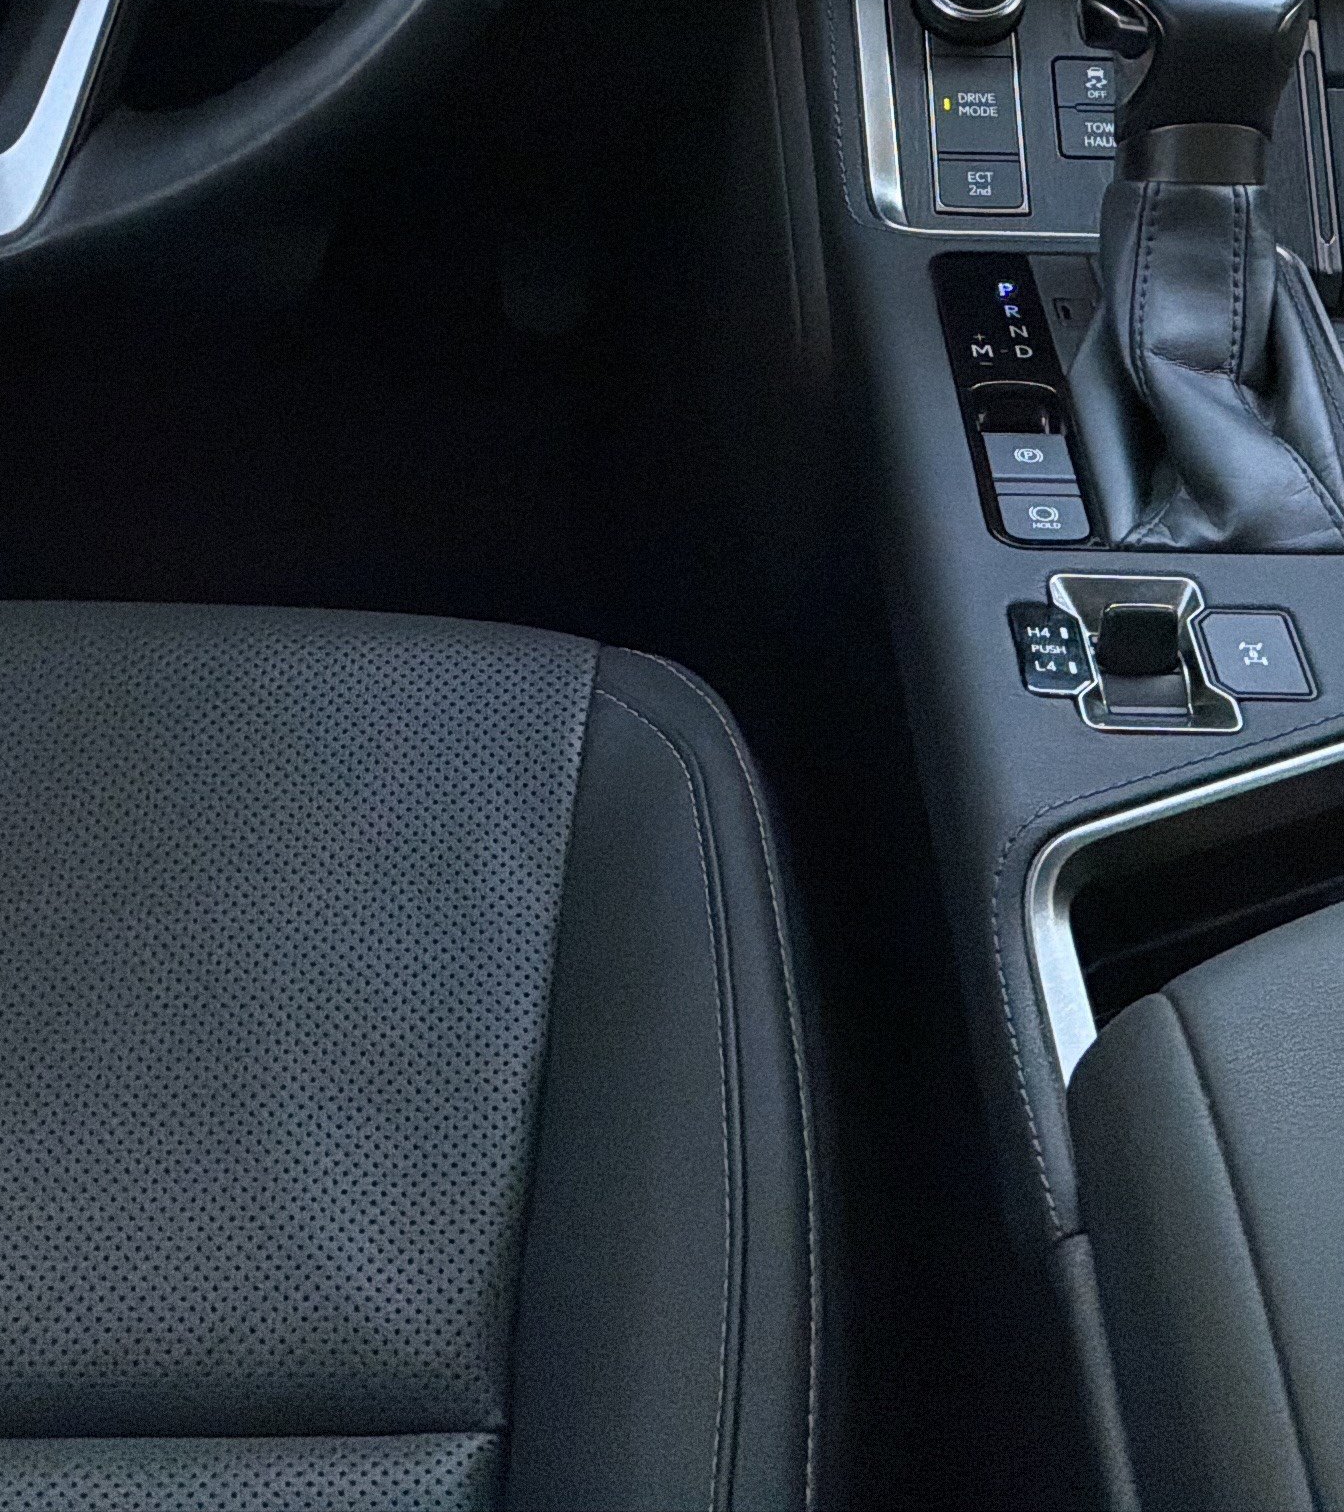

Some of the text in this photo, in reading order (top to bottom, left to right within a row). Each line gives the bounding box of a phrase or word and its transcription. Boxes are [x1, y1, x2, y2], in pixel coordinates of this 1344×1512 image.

[958, 92, 997, 105] DRIVE
[1087, 89, 1107, 100] OFF
[958, 105, 999, 118] MODE
[1084, 122, 1115, 134] TOW
[967, 171, 994, 183] ECT
[968, 184, 992, 196] 2nd
[998, 281, 1016, 299] P
[1005, 304, 1021, 319] R
[1010, 325, 1029, 339] N
[971, 344, 1034, 359] M D
[1032, 519, 1061, 530] HOLD
[1027, 626, 1051, 639] H4
[1031, 643, 1067, 655] PUSH
[1034, 660, 1057, 672] L4
